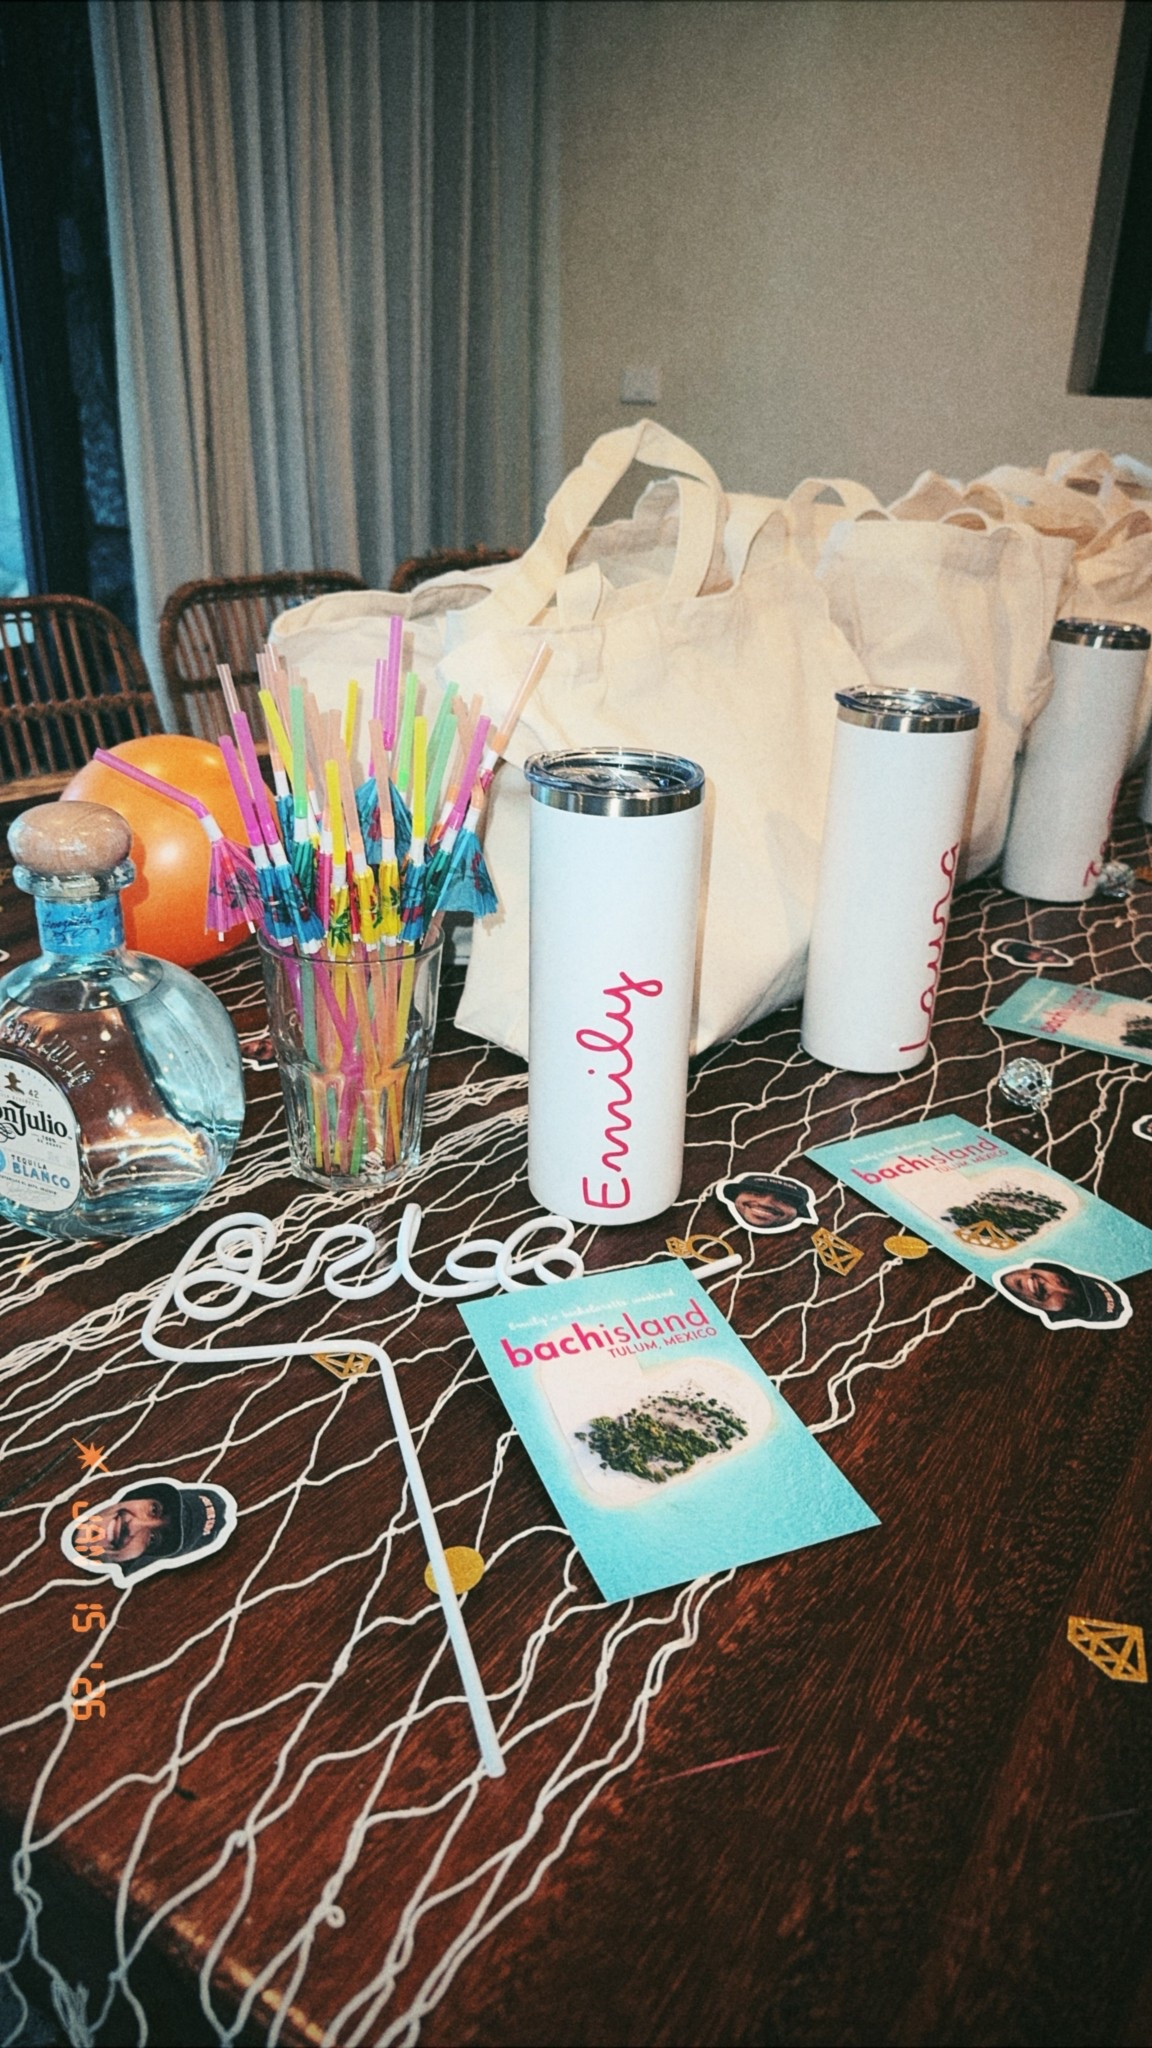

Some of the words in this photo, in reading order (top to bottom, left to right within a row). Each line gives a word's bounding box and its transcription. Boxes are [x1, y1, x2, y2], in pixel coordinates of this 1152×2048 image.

[576, 971, 663, 1210] Emily
[11, 1154, 47, 1170] TEQUILA
[12, 1162, 71, 1190] BLANCO
[850, 1135, 1000, 1185] bachisland
[500, 1297, 710, 1368] bachisland
[608, 1341, 662, 1359] TULUM,
[663, 1326, 717, 1347] MEXICO
